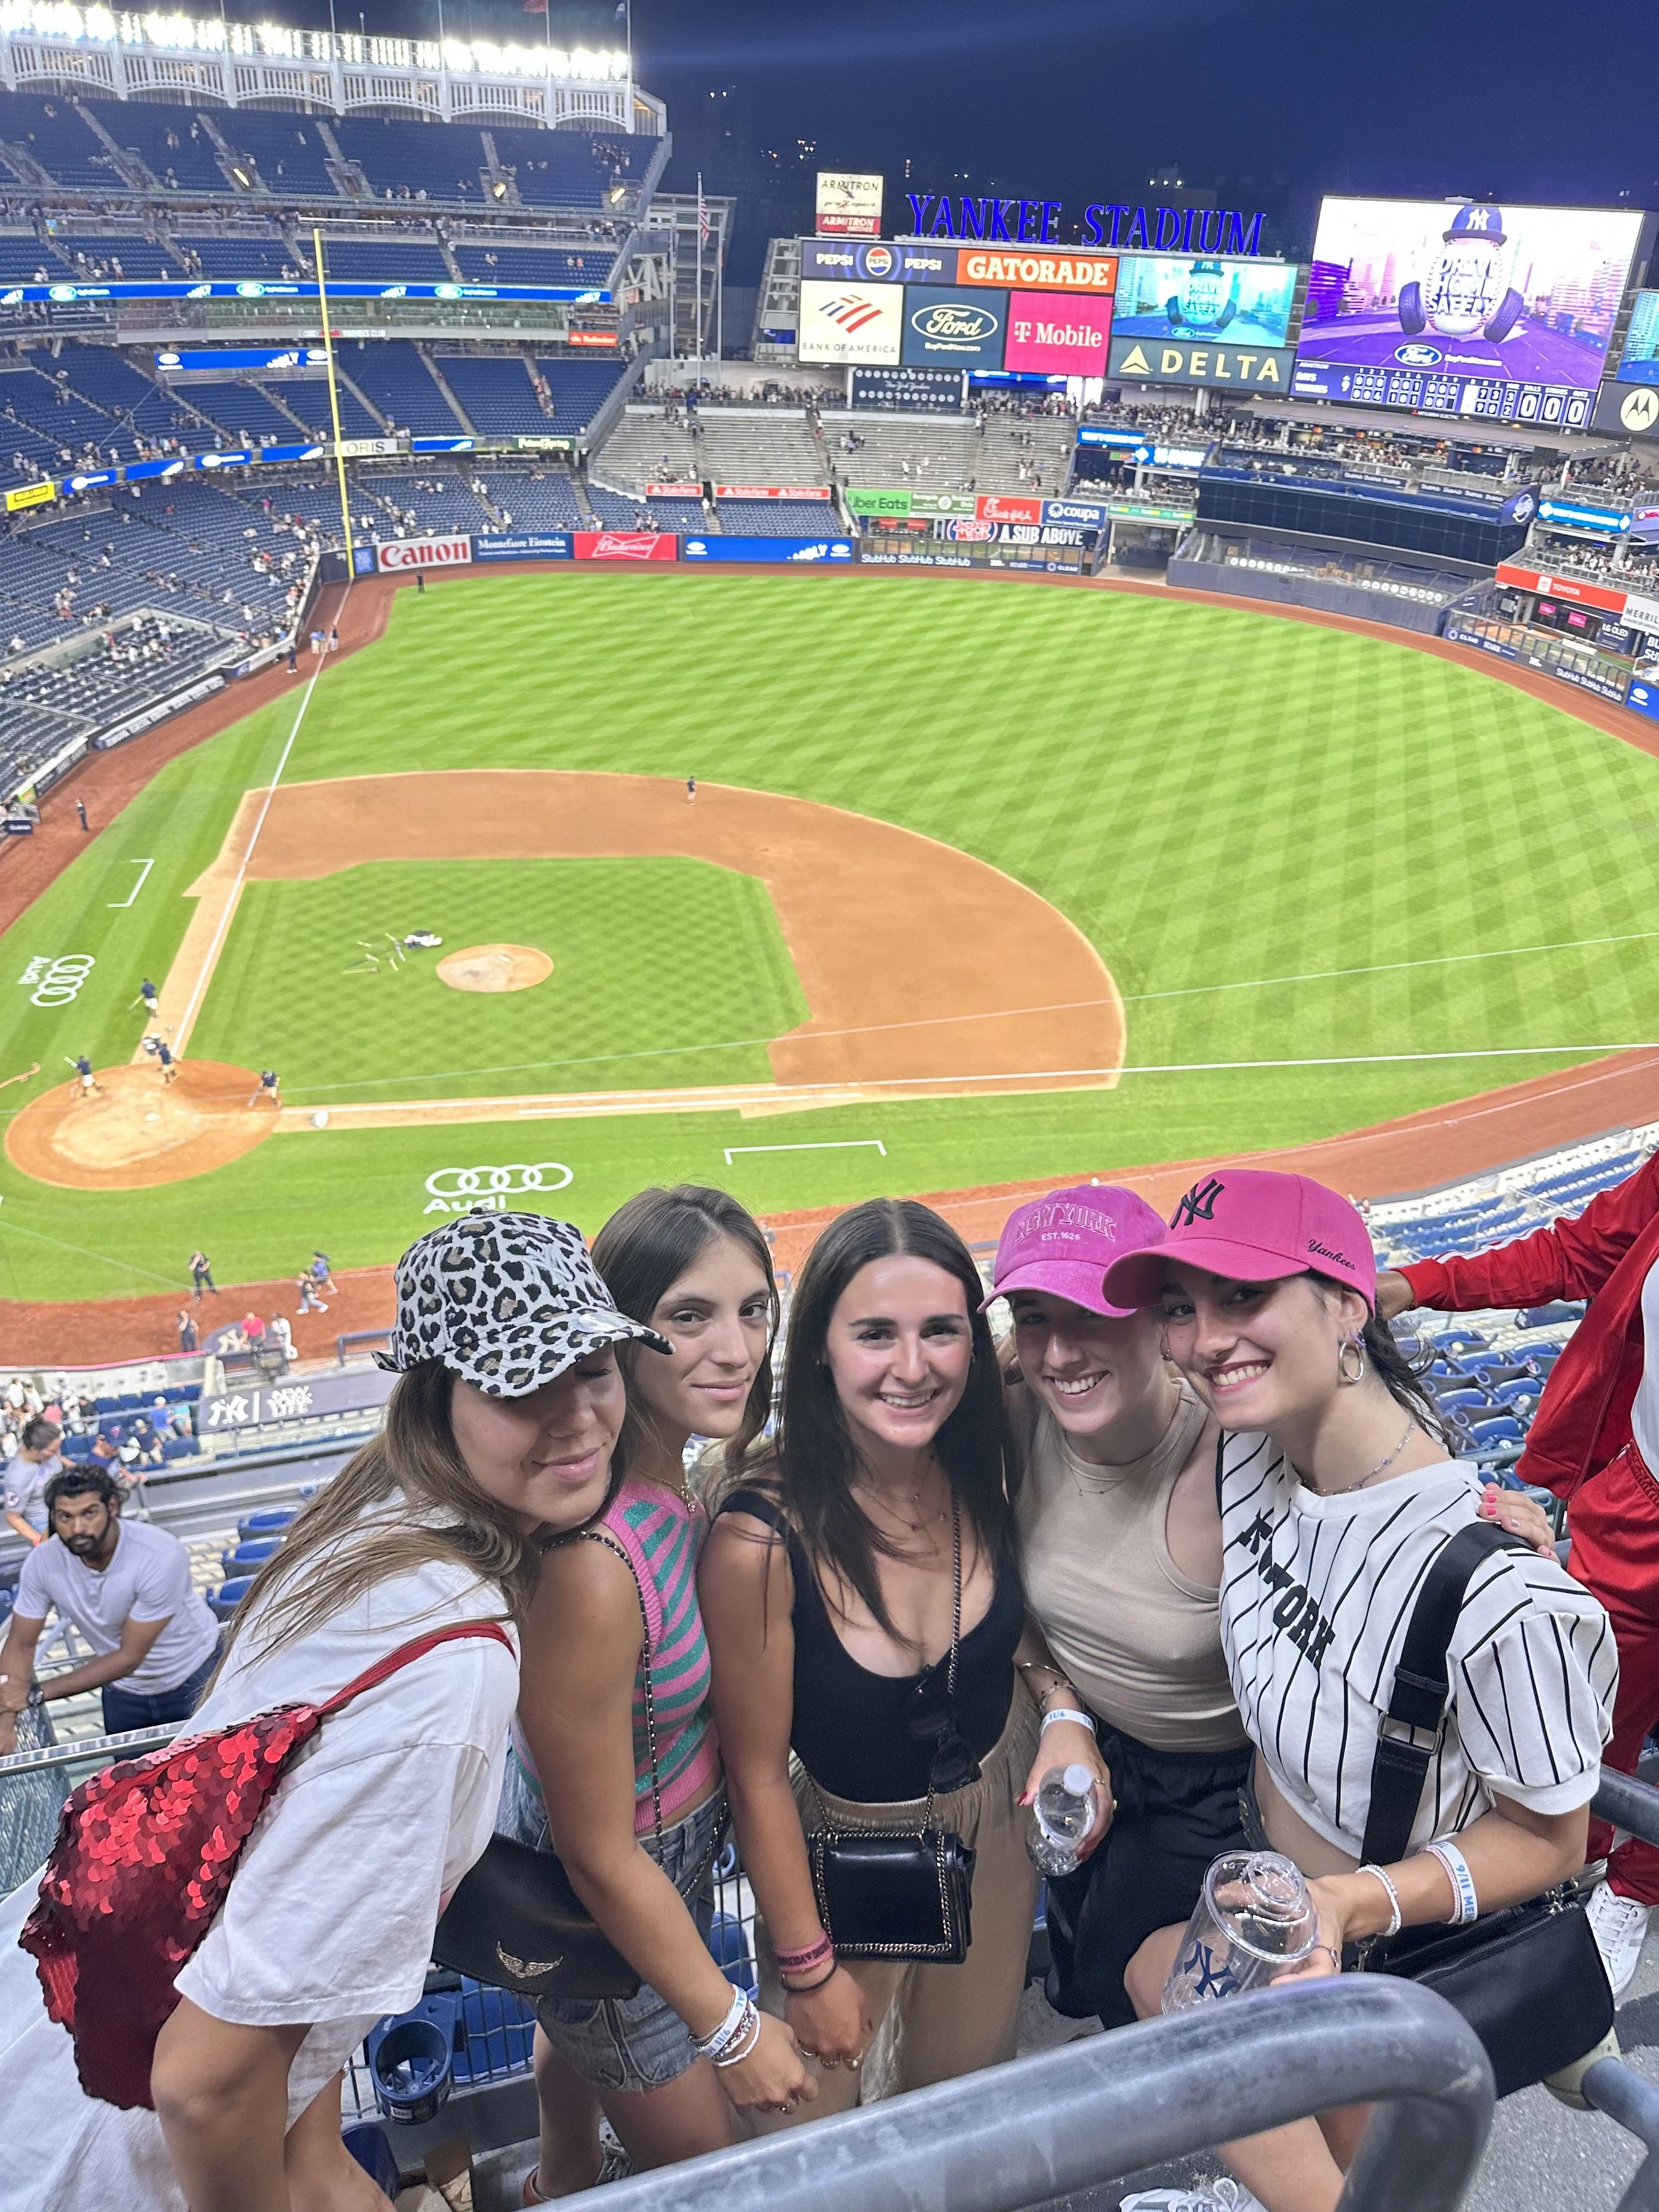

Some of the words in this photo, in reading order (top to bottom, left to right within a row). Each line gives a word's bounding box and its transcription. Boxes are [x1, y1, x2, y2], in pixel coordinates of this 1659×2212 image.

[821, 180, 879, 191] ARMITRON
[822, 216, 875, 227] ARMITRON
[906, 193, 1062, 244] YANKEE
[1082, 204, 1266, 256] STADIUM
[816, 253, 853, 265] PEPSI
[904, 258, 942, 271] PEPSI
[967, 256, 1110, 286] GATORADE
[926, 307, 981, 336] Ford
[1036, 323, 1103, 347] Mobile
[802, 342, 831, 351] BANK
[833, 343, 847, 352] OF
[849, 344, 896, 353] AMERICA
[1401, 346, 1435, 364] Ford
[1161, 349, 1279, 383] DELTA
[1520, 394, 1537, 417] 0
[1544, 397, 1561, 420] 0
[1567, 400, 1585, 423] 0
[346, 441, 385, 455] ORIS
[879, 498, 908, 510] Eats
[1064, 506, 1100, 522] coupa
[999, 524, 1010, 541] A
[1012, 524, 1040, 543] SUB
[1041, 527, 1084, 546] ABOVE
[380, 542, 469, 568] Canon
[599, 539, 653, 552] Budweiser
[861, 554, 897, 563] StubHub
[898, 554, 934, 565] StubHub
[935, 556, 971, 567] StubHub
[1552, 583, 1581, 597] TOYOTA
[423, 1195, 506, 1215] Audi
[1015, 1203, 1060, 1244] NEW
[1058, 1203, 1116, 1242] YORK
[1308, 1238, 1356, 1271] Yankees
[1456, 1864, 1471, 1889] 9/11
